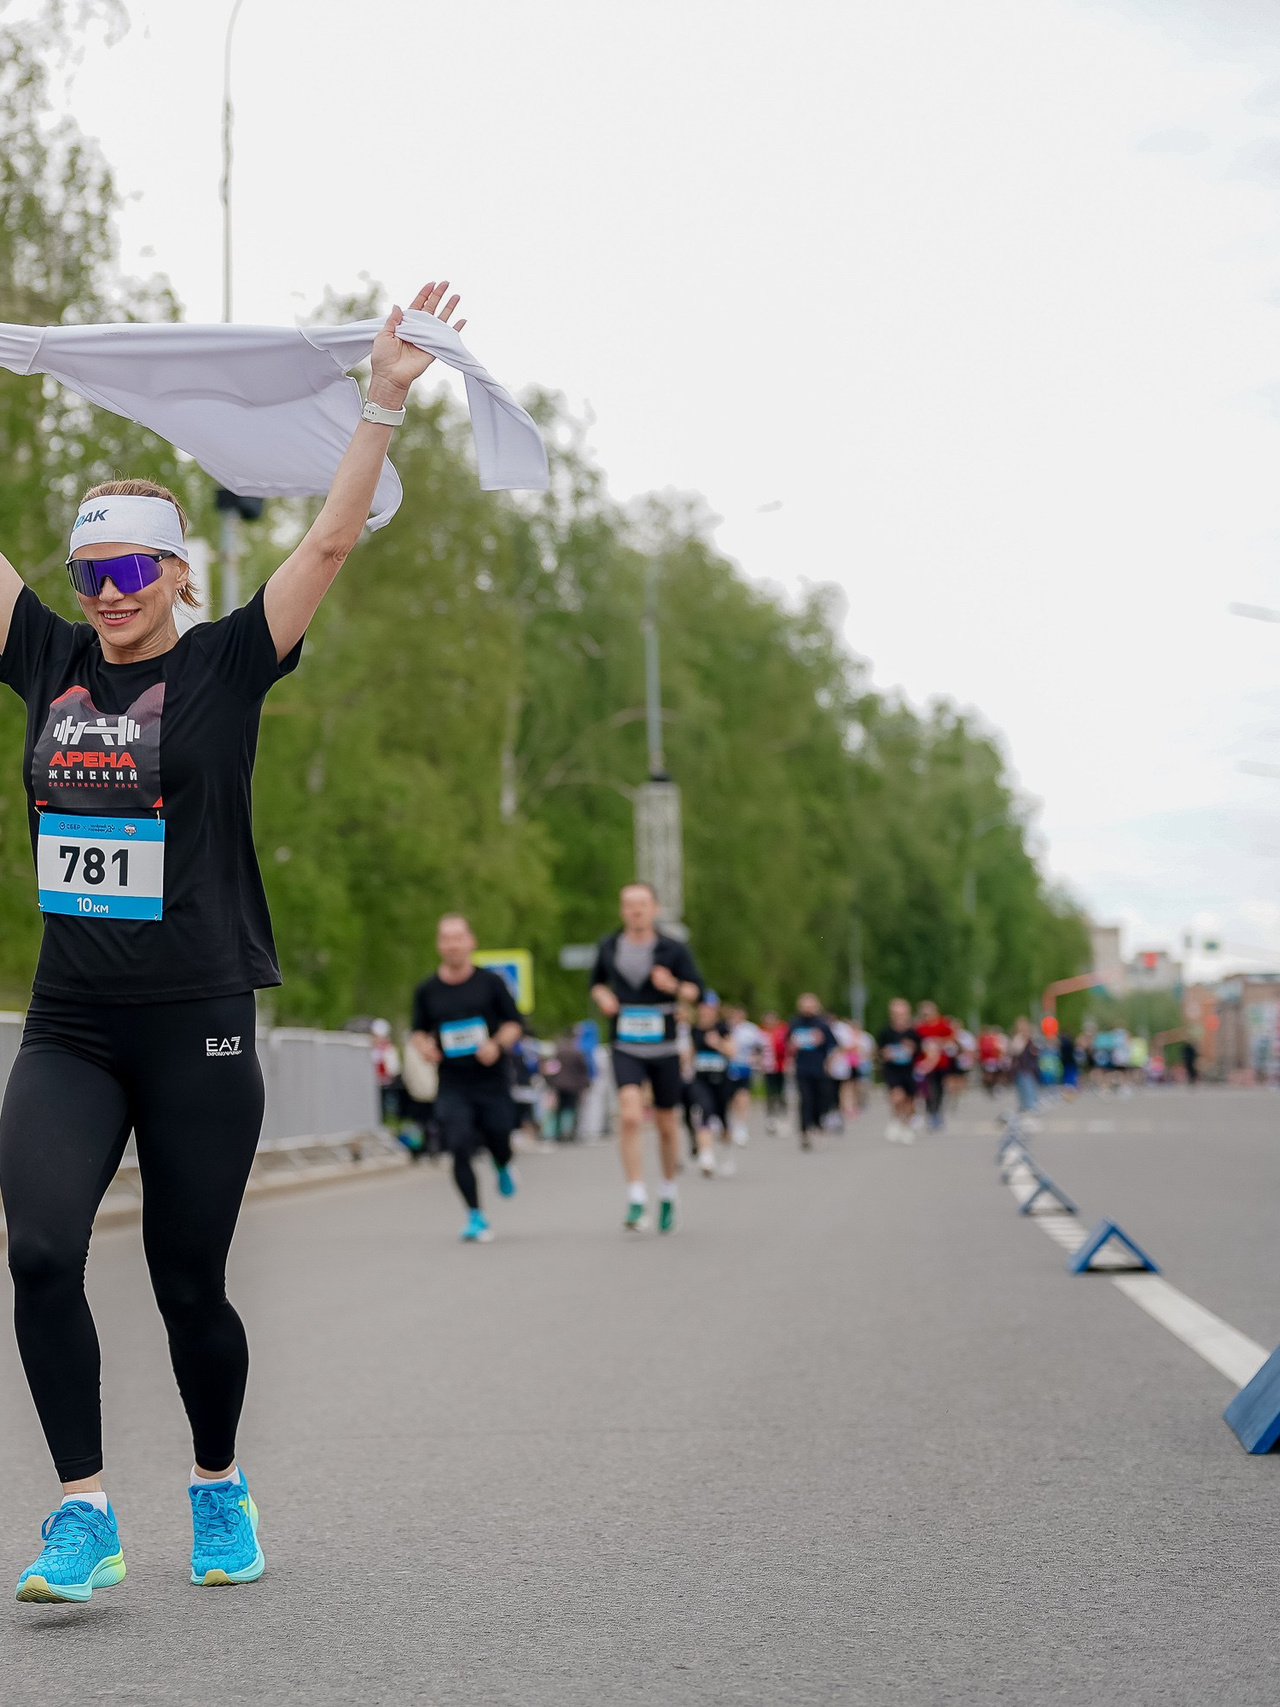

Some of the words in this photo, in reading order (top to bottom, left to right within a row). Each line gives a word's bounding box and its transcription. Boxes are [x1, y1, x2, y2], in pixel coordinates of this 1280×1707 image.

[49, 751, 136, 768] АРЕНА
[49, 769, 138, 780] ЖЕНСКИЙ
[59, 845, 129, 887] 781
[206, 1036, 241, 1051] EA7
